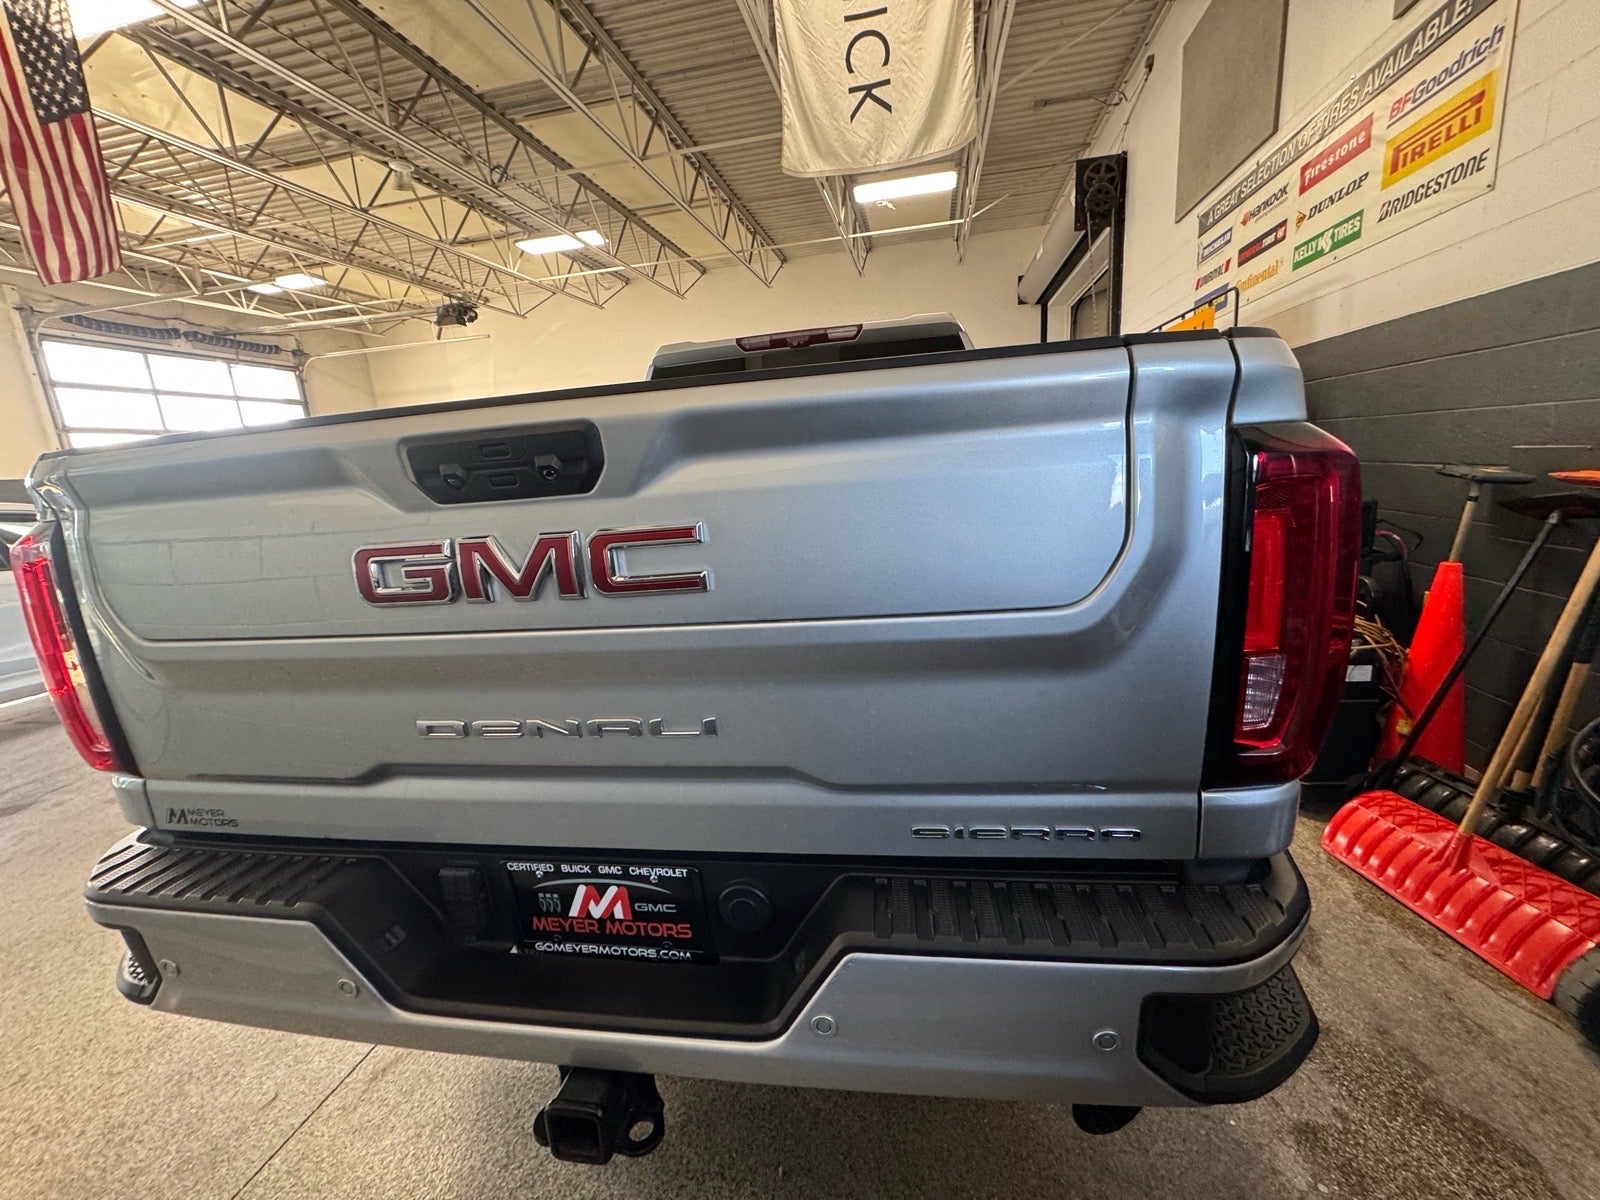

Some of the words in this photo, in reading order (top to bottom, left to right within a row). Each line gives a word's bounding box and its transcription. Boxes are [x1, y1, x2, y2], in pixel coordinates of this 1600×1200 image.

[844, 0, 892, 124] ICK
[1388, 24, 1505, 121] BFGoodrich
[1214, 187, 1242, 218] GREAT
[1240, 142, 1296, 199] SELECTION
[1299, 125, 1318, 150] OF
[1317, 86, 1360, 132] TIRES
[1390, 89, 1486, 175] PIRELLI
[1304, 130, 1366, 186] Firestone
[1307, 171, 1369, 220] DUNLOP
[1377, 148, 1490, 223] BRIDGESTONE
[1294, 238, 1319, 263] KELLY
[1333, 216, 1361, 242] TIRES
[352, 521, 711, 607] GMC
[416, 717, 719, 739] DENALI
[187, 808, 225, 818] MEYER
[189, 818, 239, 827] MOTORS
[911, 824, 1142, 841] SIERRA
[506, 862, 554, 873] CERTIFIED
[560, 864, 592, 874] BUICK
[598, 865, 622, 875] GMC
[629, 866, 688, 878] CHEVROLET
[532, 916, 600, 934] MEYER
[606, 920, 693, 939] MOTORS
[634, 902, 677, 913] GMC
[534, 942, 692, 960] GOMEYERMOTORS.COM
